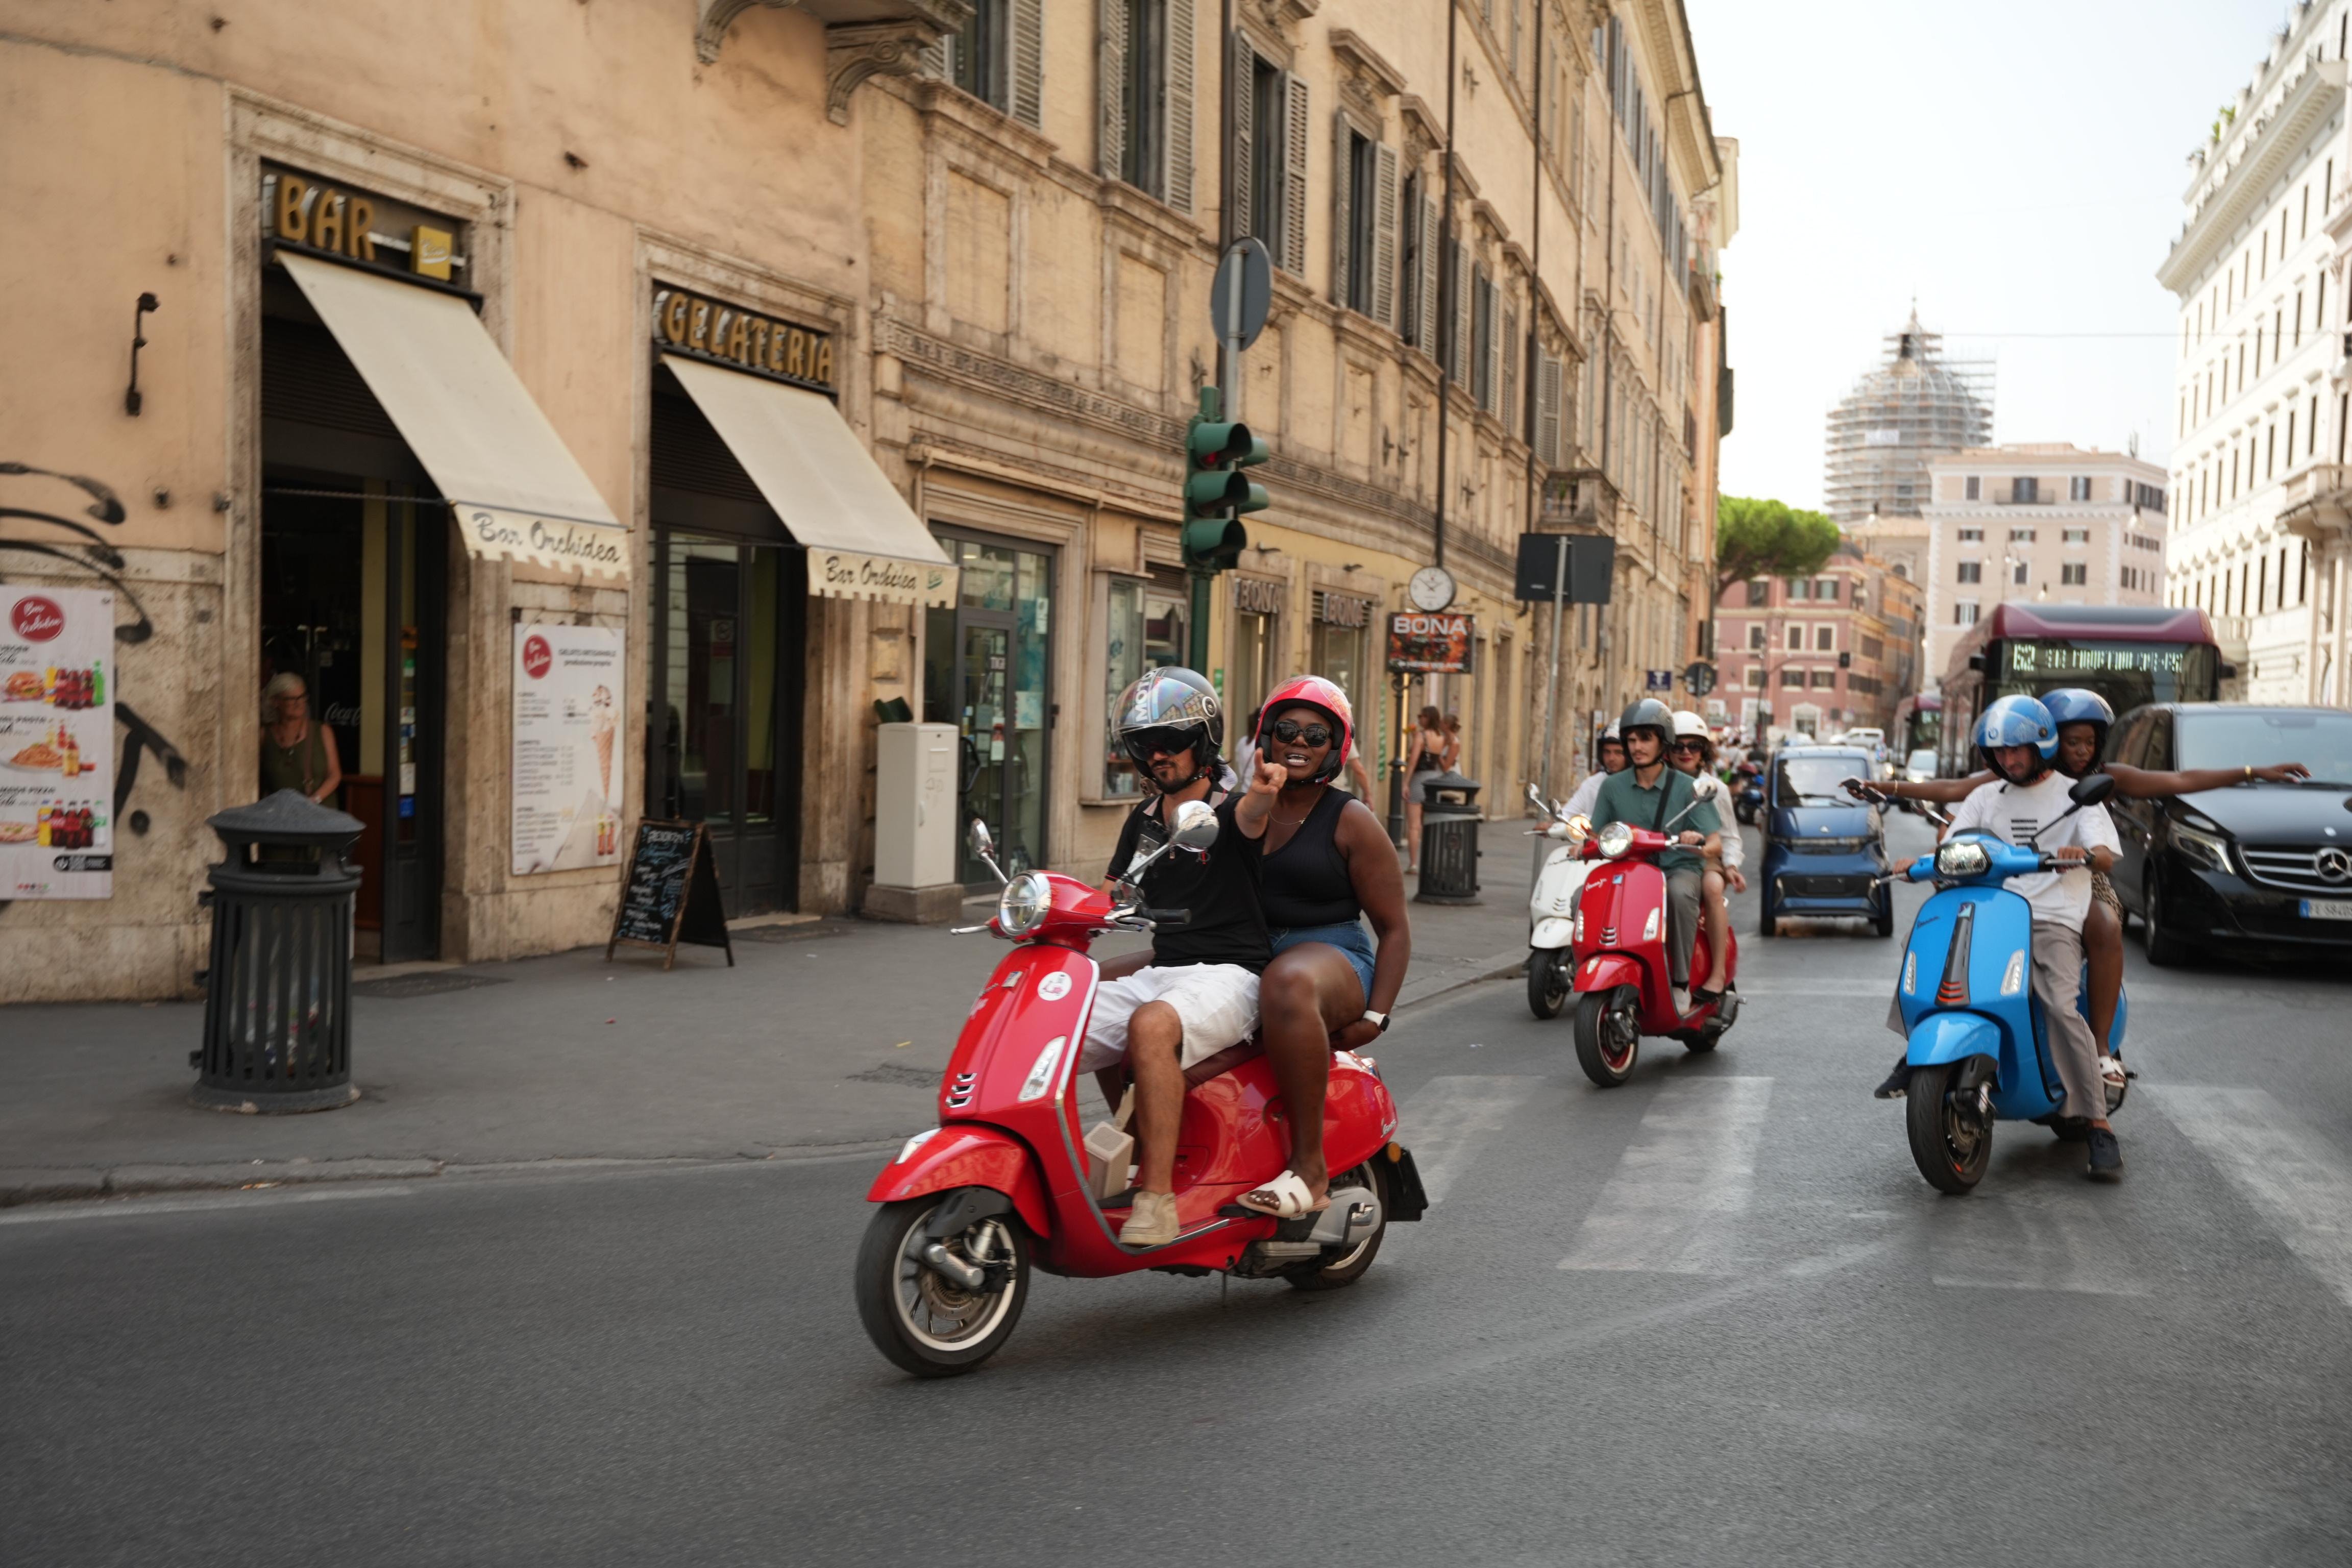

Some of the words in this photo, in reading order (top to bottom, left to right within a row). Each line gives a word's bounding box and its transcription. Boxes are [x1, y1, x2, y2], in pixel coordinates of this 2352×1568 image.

[277, 175, 375, 262] BAR
[664, 292, 834, 382] GELATERIA
[472, 512, 523, 546] Bar
[530, 520, 622, 564] Orchidea
[825, 556, 855, 583] Bar
[1393, 617, 1467, 635] BONA
